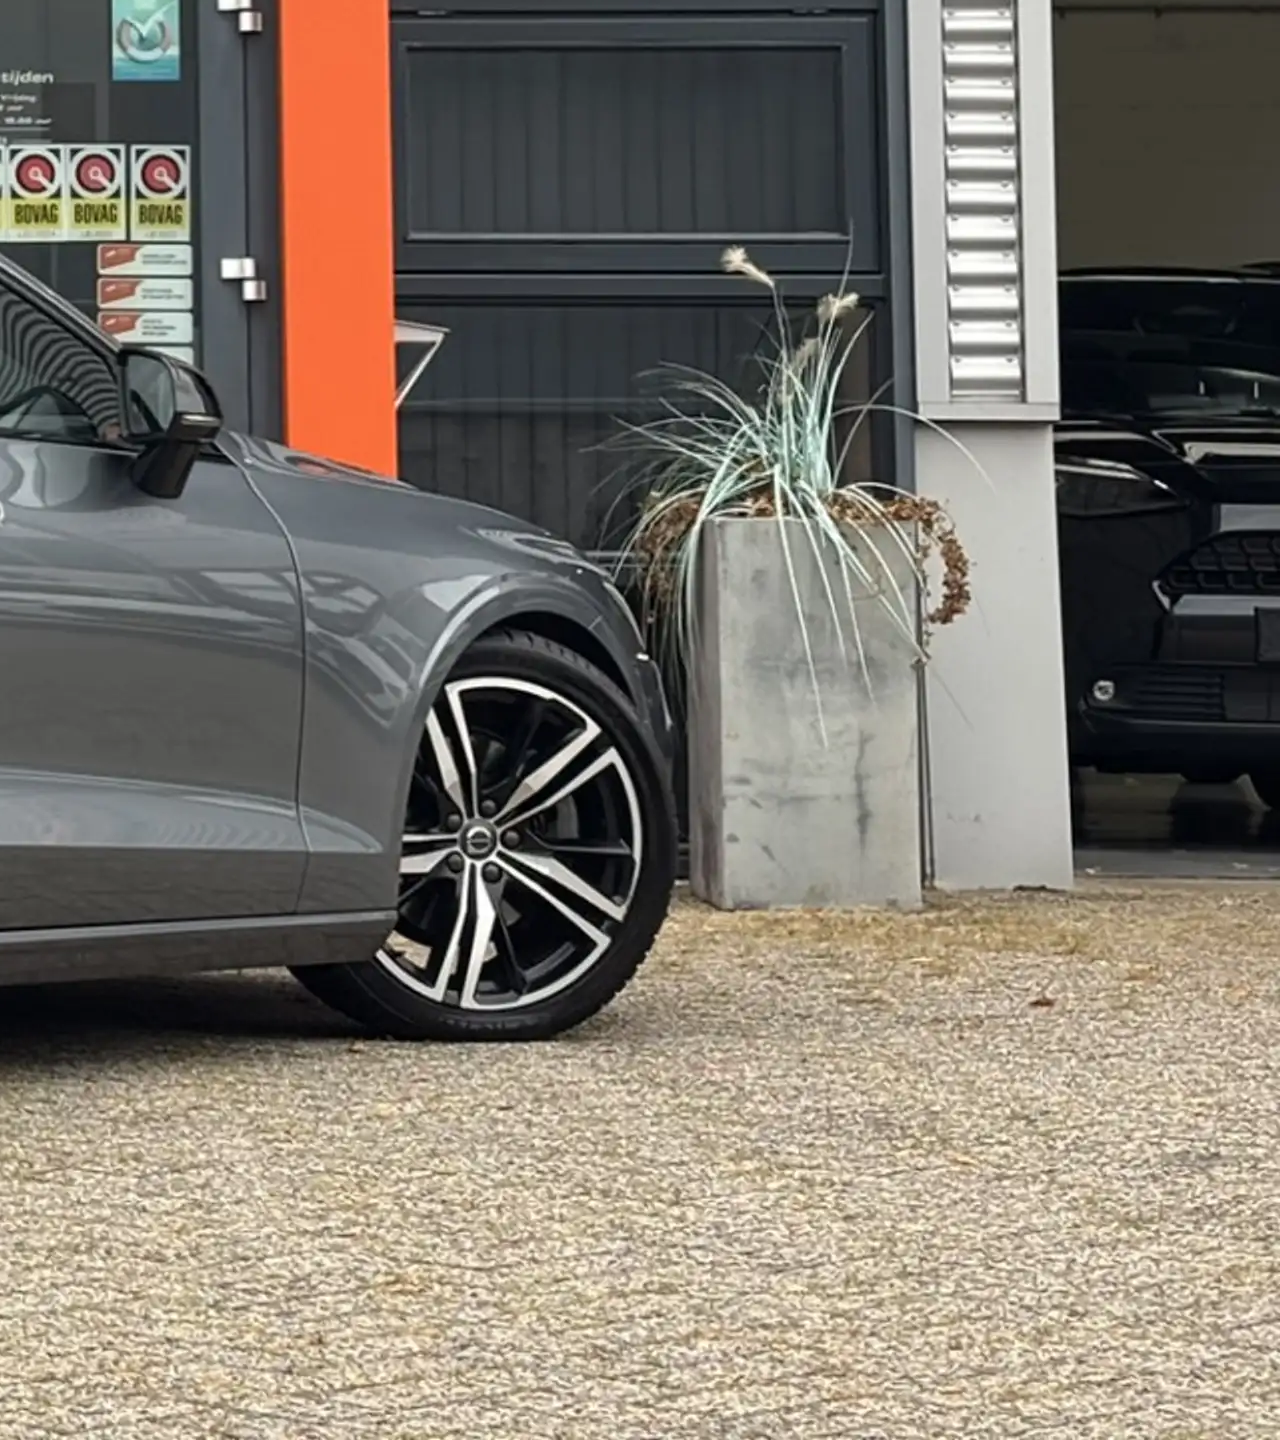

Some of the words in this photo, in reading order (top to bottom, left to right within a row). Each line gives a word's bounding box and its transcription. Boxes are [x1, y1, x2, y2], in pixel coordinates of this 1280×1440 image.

[14, 203, 58, 224] BOVAG
[74, 203, 117, 224] BOVAG
[139, 203, 183, 224] BOVAG
